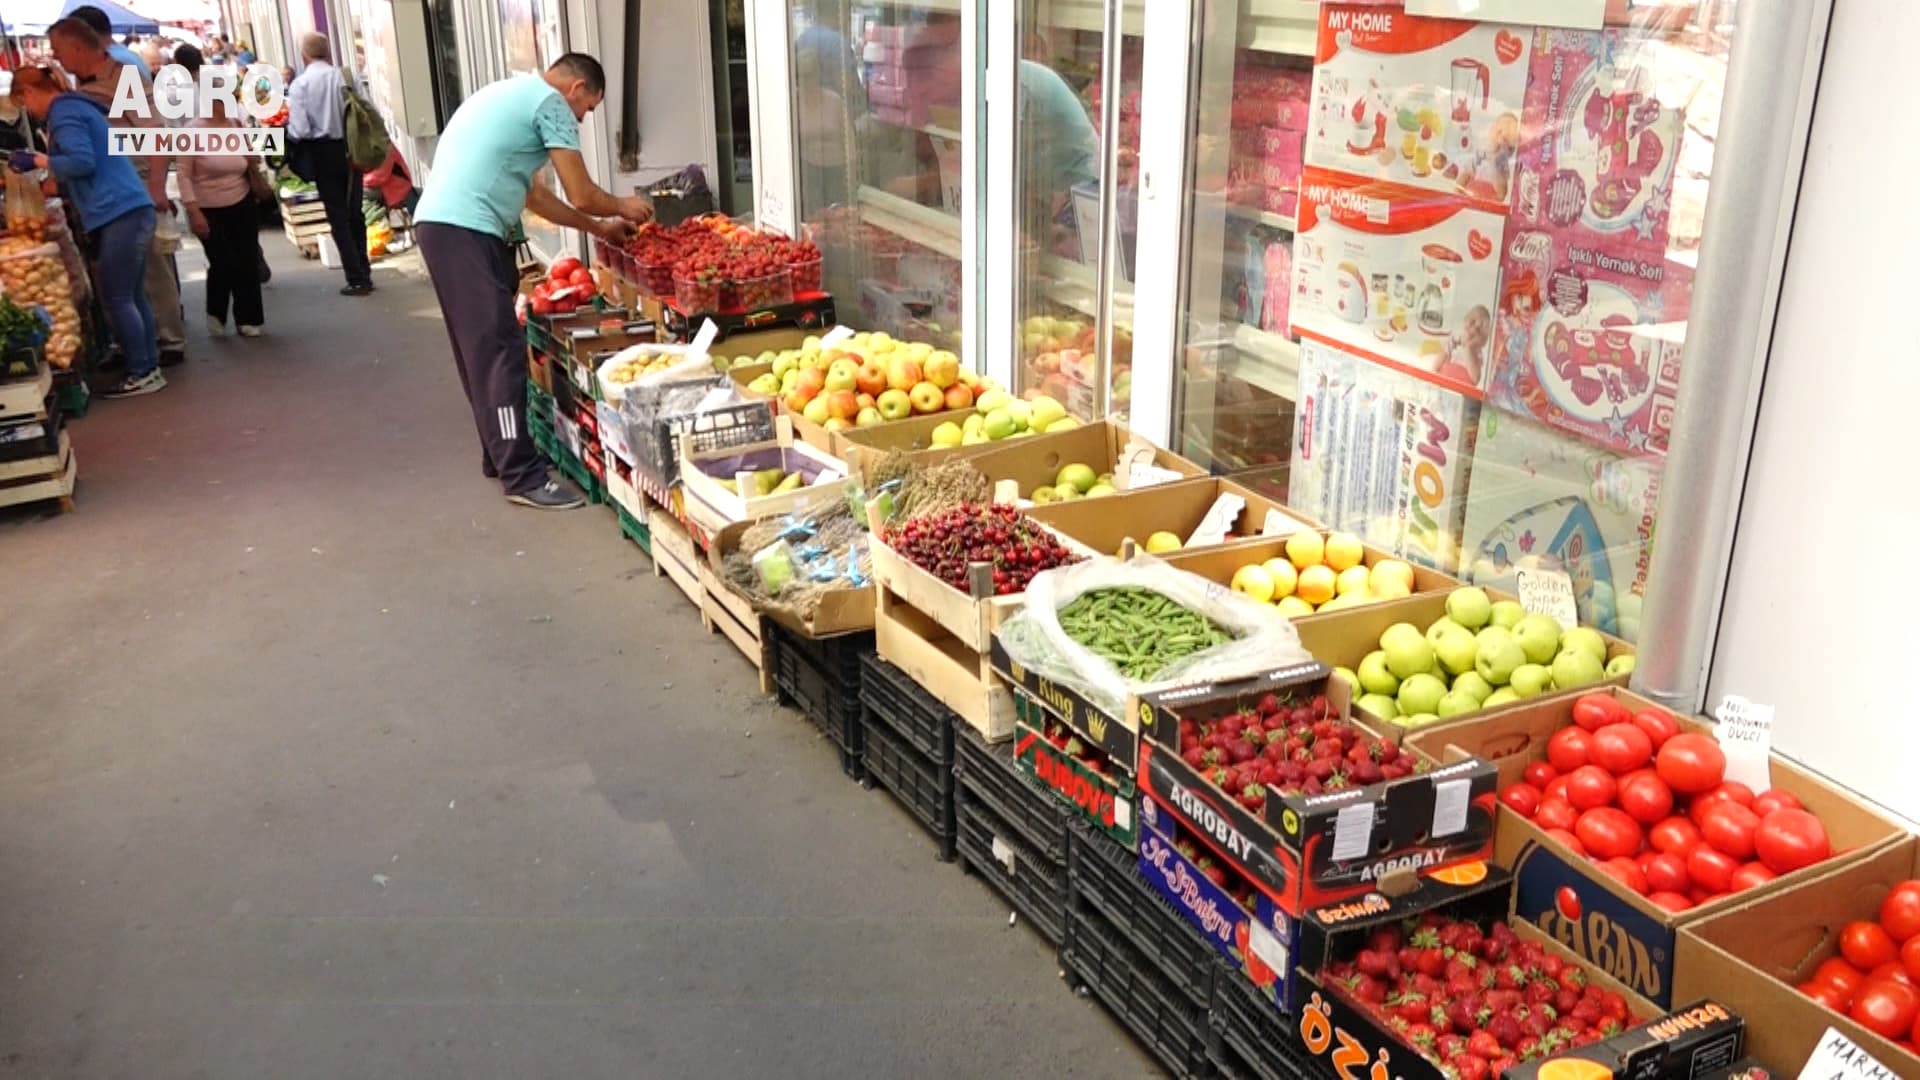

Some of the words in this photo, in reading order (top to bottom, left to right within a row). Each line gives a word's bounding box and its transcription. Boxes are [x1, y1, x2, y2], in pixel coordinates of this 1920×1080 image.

[1328, 11, 1349, 29] MY
[1351, 12, 1392, 33] HOME
[1308, 184, 1329, 204] MY
[1330, 189, 1369, 214] HOME
[1038, 676, 1074, 724] King
[1170, 781, 1252, 861] AGROBAY
[1360, 847, 1447, 882] AGROBAY
[1826, 1037, 1897, 1080] MARM
